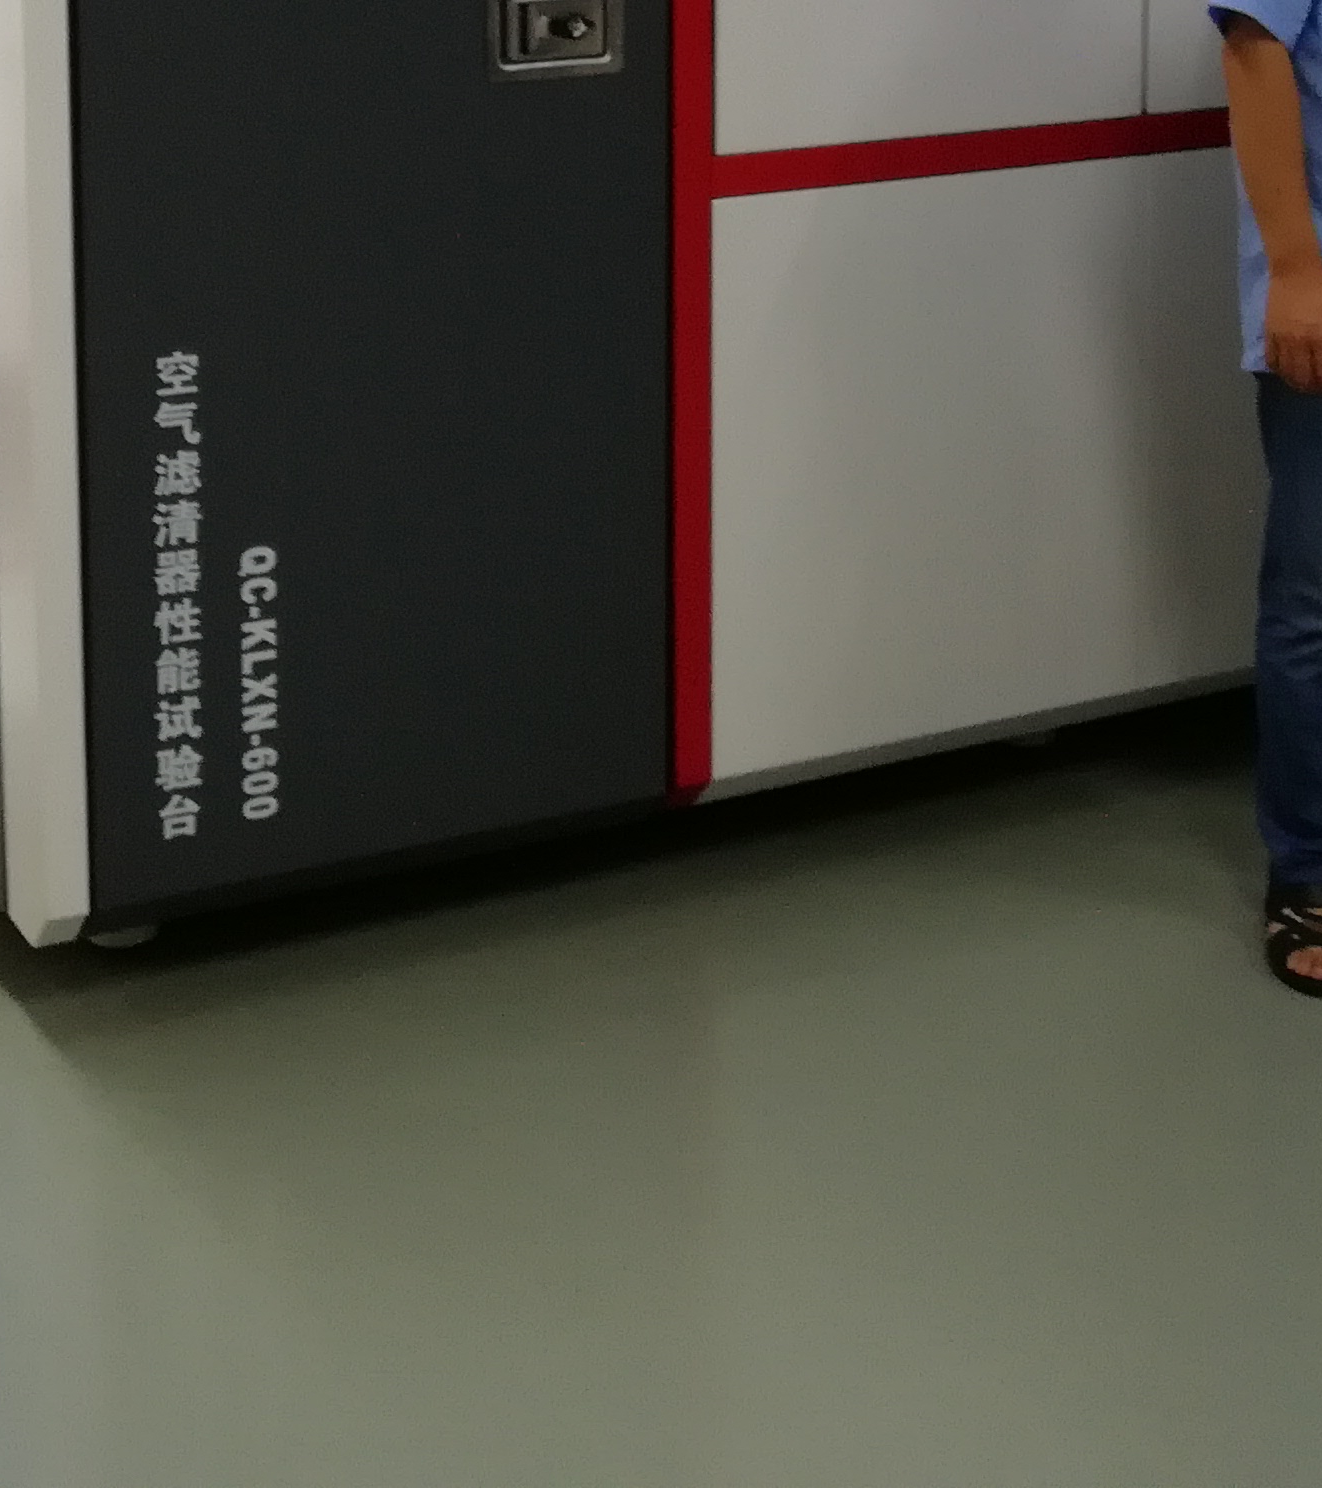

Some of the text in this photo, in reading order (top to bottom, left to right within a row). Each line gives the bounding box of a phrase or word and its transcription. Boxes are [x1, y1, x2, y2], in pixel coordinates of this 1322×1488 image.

[152, 350, 204, 840] 空气滤清器性能试验台
[237, 545, 279, 820] QC-KLXN-600
